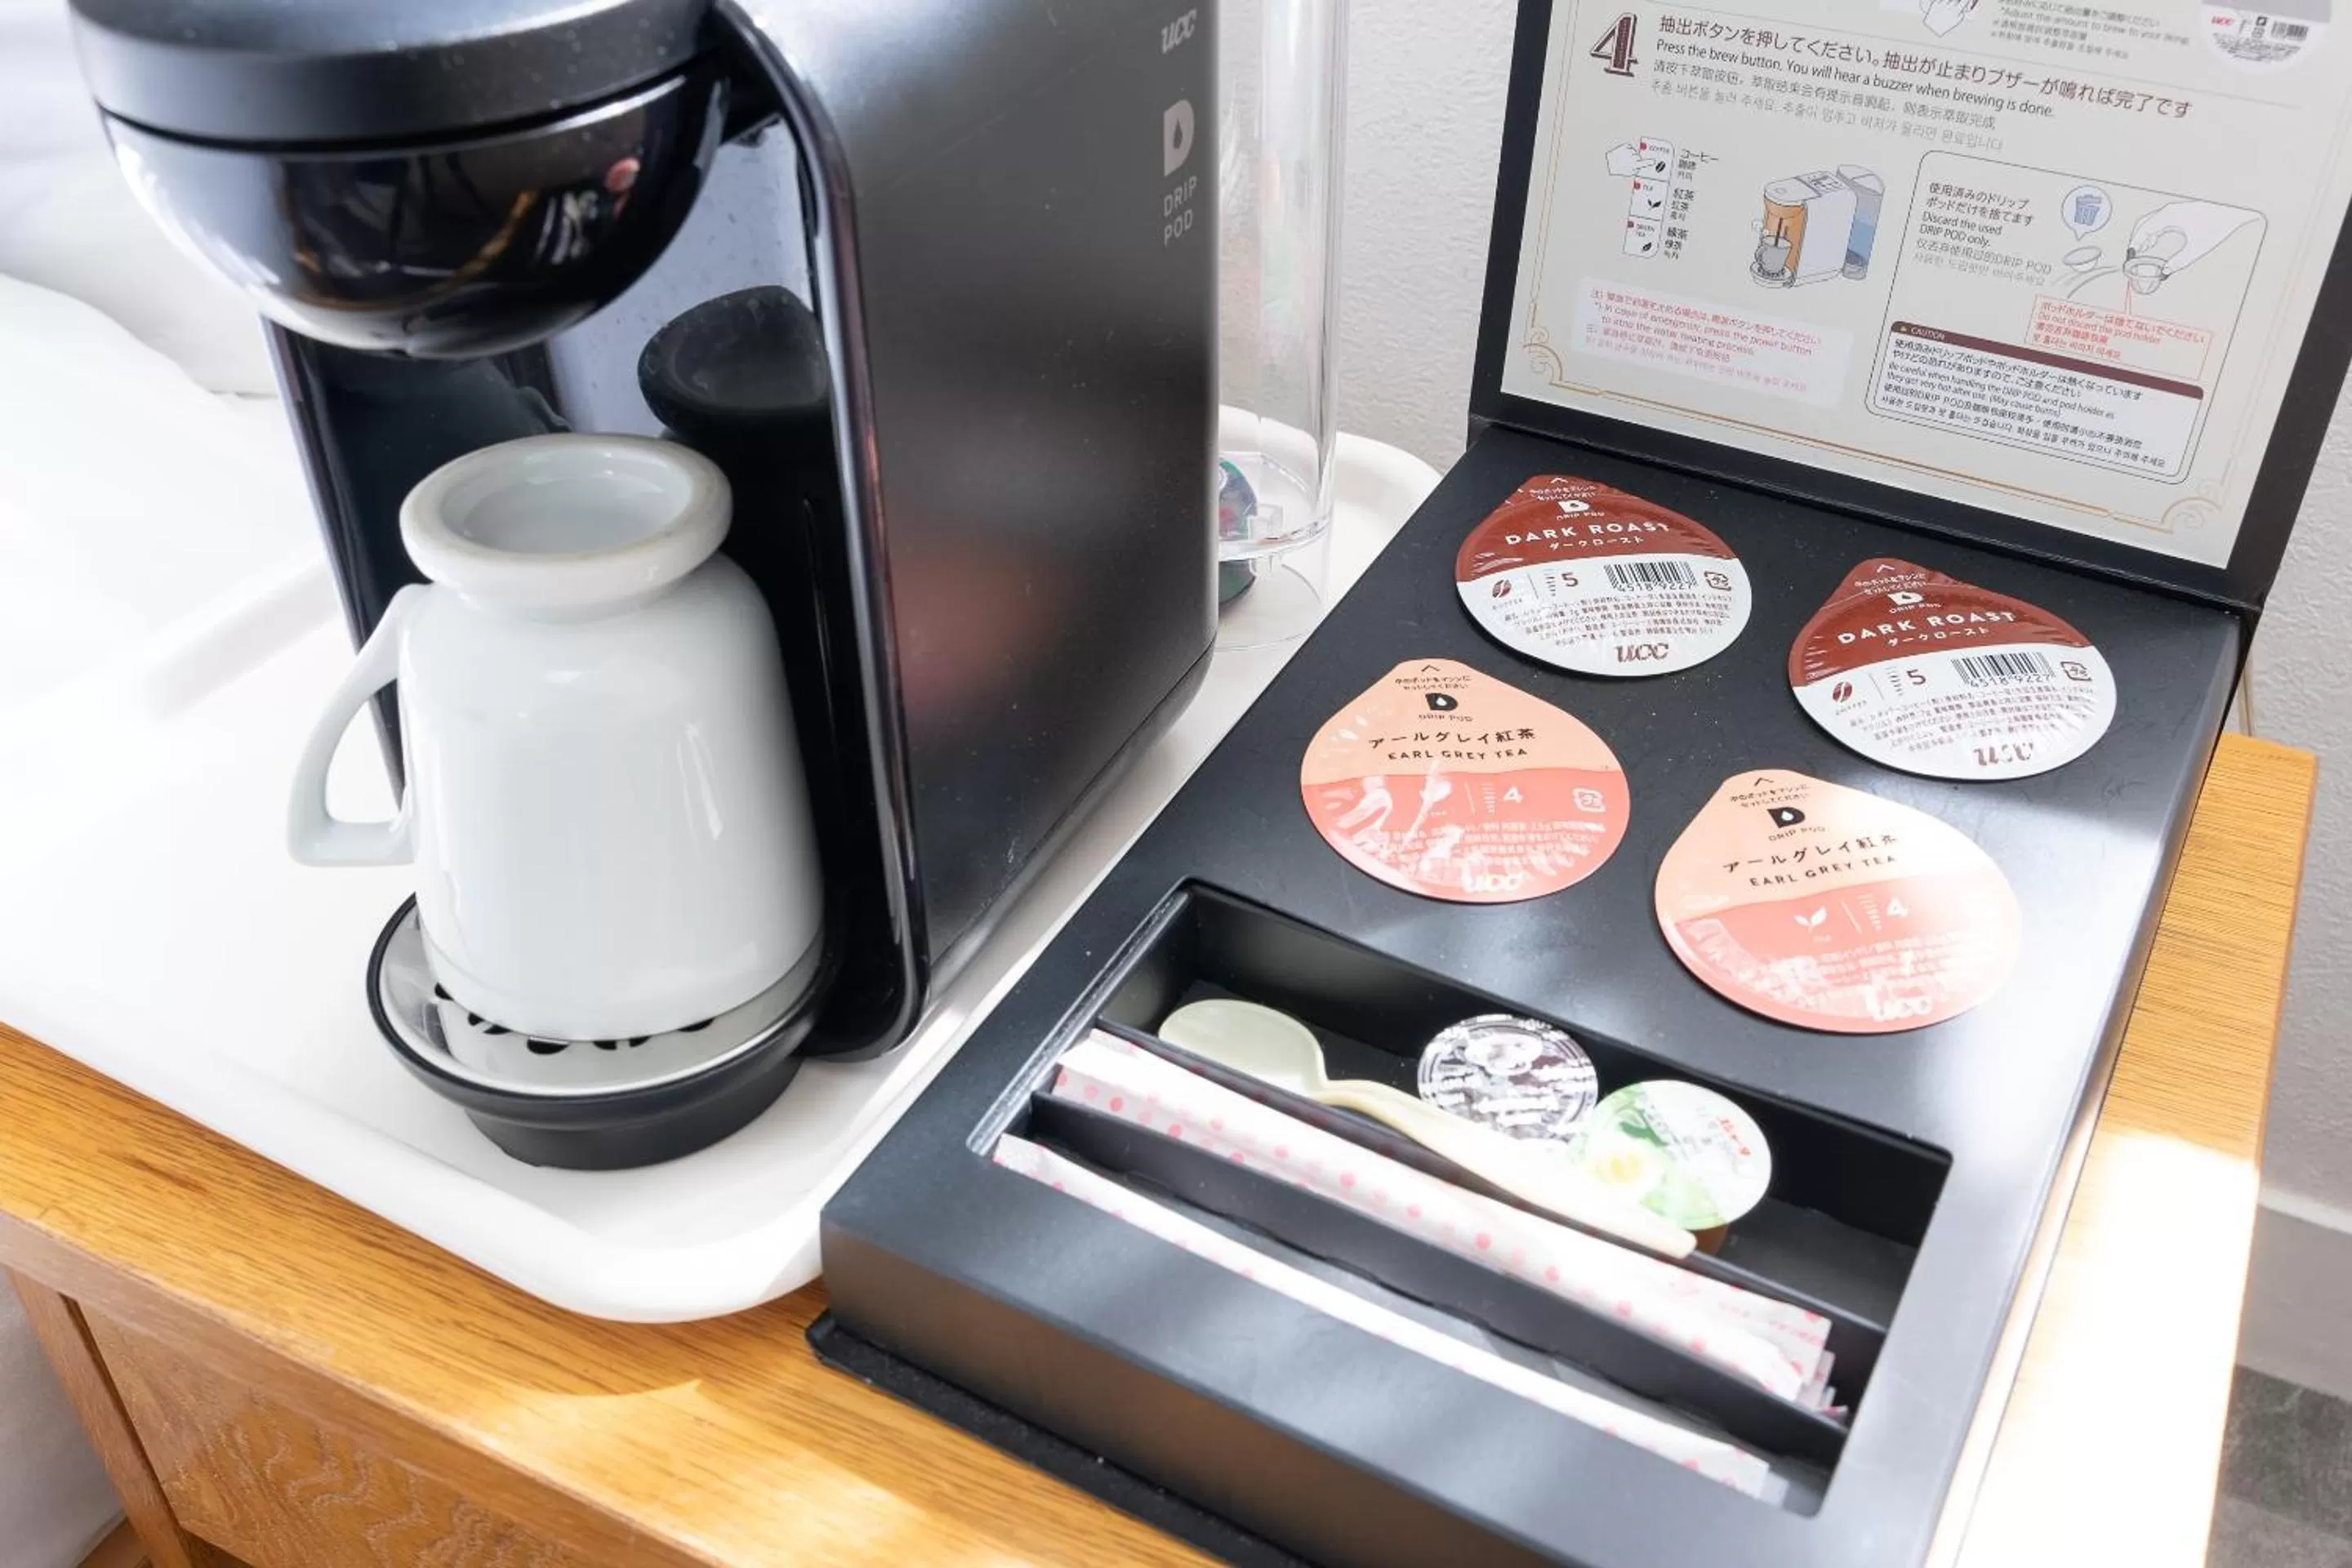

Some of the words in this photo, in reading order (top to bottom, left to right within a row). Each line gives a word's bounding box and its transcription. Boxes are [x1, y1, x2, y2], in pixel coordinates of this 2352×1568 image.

[1589, 12, 1639, 78] 4
[1655, 38, 1686, 55] Press
[1687, 43, 1708, 59] the
[1708, 47, 1739, 64] brew
[1741, 52, 1784, 71] button.
[1785, 60, 1810, 75] You
[1811, 64, 1833, 78] will
[1833, 67, 1861, 84] hear
[1871, 73, 1914, 93] buzzer
[1915, 80, 1951, 99] when
[1952, 87, 2006, 112] brewing
[2006, 97, 2018, 111] is
[1164, 176, 1197, 217] DRIP
[1929, 183, 2029, 209] 使用済みのドリップ
[1164, 208, 1193, 247] POD
[1922, 211, 1958, 226] Discard
[1960, 220, 1976, 231] the
[1979, 225, 2002, 236] used
[1919, 224, 1943, 236] DRIP
[1944, 229, 1967, 242] POD
[1967, 235, 1990, 248] only.
[1505, 526, 1577, 546] DARK
[1588, 522, 1669, 535] ROAST
[1561, 572, 1579, 587] 5
[1838, 620, 1916, 644] DARK
[1927, 612, 2016, 626] ROAST
[1888, 627, 1989, 646] ダークロースト
[1906, 669, 1927, 686] 5
[1369, 728, 1535, 748] アールグレイ紅茶
[1388, 750, 1434, 760] EARL
[1441, 751, 1486, 760] GREY
[1496, 749, 1528, 758] TEA
[1503, 786, 1524, 804] 4
[1768, 828, 1796, 841] DRIP
[1723, 834, 1897, 873] アールグレイ紅茶
[1750, 874, 1798, 887] EARL
[1806, 862, 1854, 878] GREY
[1862, 855, 1895, 866] TEA
[1886, 897, 1909, 917] 4
